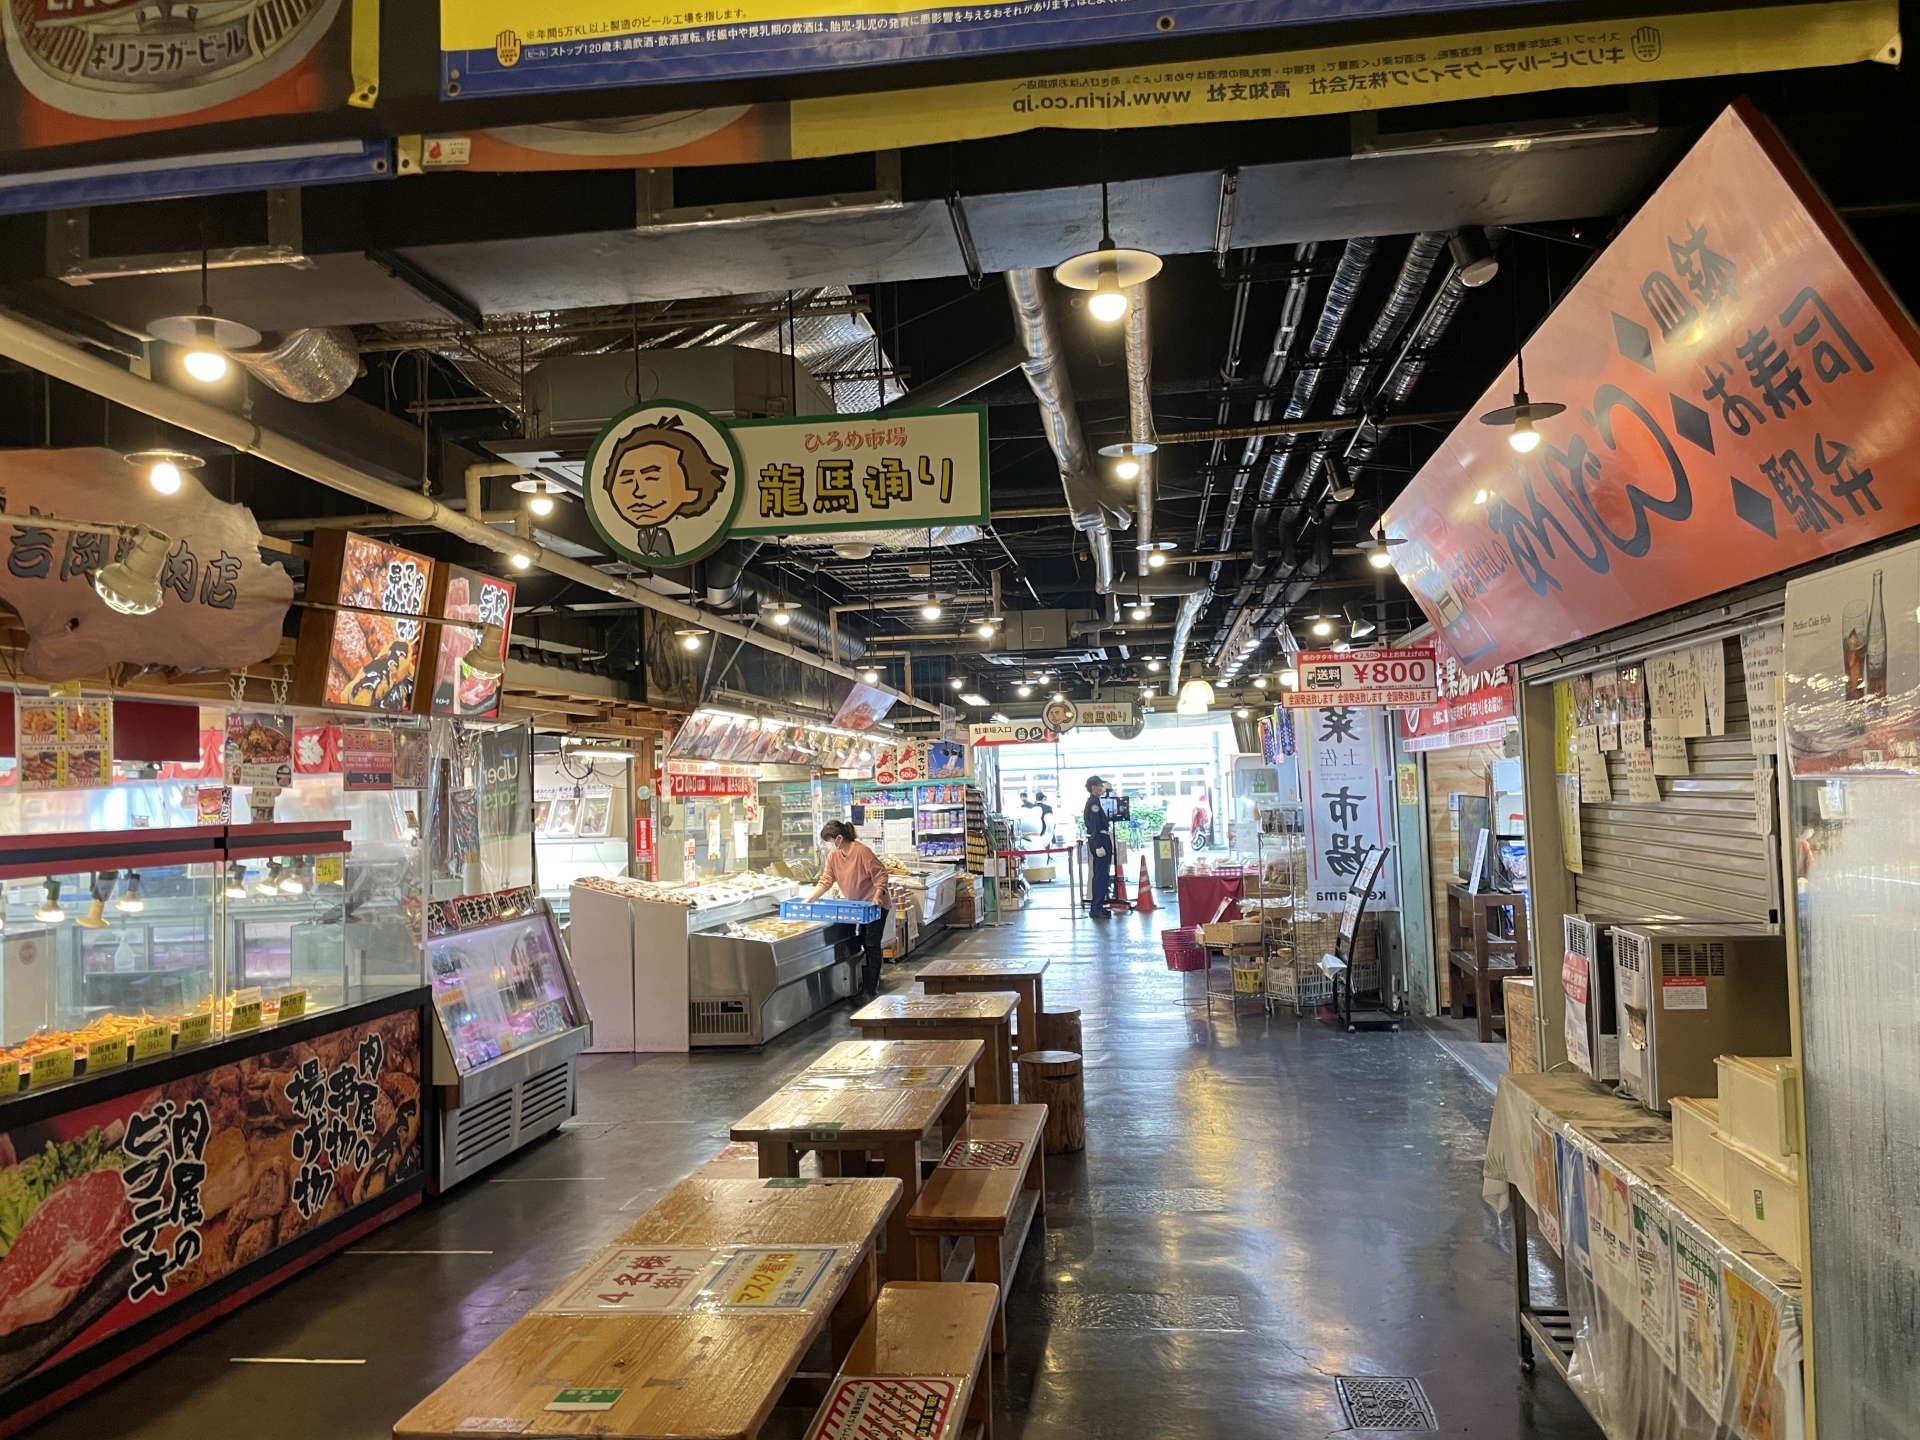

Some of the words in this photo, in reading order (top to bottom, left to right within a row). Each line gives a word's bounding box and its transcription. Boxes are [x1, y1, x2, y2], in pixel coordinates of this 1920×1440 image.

[90, 28, 246, 77] キリンラガービール
[1640, 219, 1740, 346] 皿鉢
[1702, 285, 1875, 437] お寿司
[804, 426, 908, 453] ひろめ市場
[757, 455, 954, 518] 龍馬通り
[1759, 431, 1883, 535] 駅弁
[7, 505, 243, 610] 吉岡肉店
[1808, 616, 1820, 629] Coke
[1354, 652, 1379, 660] ¥2,500
[1316, 668, 1341, 681] 送料
[1352, 662, 1426, 684] ¥800
[1288, 693, 1334, 706] 全国発送致します
[1338, 692, 1383, 705] 全国発送致します
[1386, 690, 1432, 703] 全国発送致します
[974, 726, 1012, 735] 駐車場入口
[1082, 711, 1127, 724] 龍馬通り
[416, 731, 425, 768] ちまき
[362, 773, 381, 784] こちら
[456, 895, 499, 926] 焼きます!
[100, 1052, 115, 1063] 90
[147, 1040, 160, 1052] 90
[352, 1031, 384, 1172] 肉屋の
[284, 1057, 335, 1219] 揚げ物
[170, 1099, 211, 1268] 肉屋の
[121, 1100, 177, 1305] ビフテキ
[596, 1254, 672, 1304] 4名様
[649, 1265, 696, 1290] 掛け
[736, 1252, 796, 1304] マスク着用
[916, 1429, 927, 1437] DO
